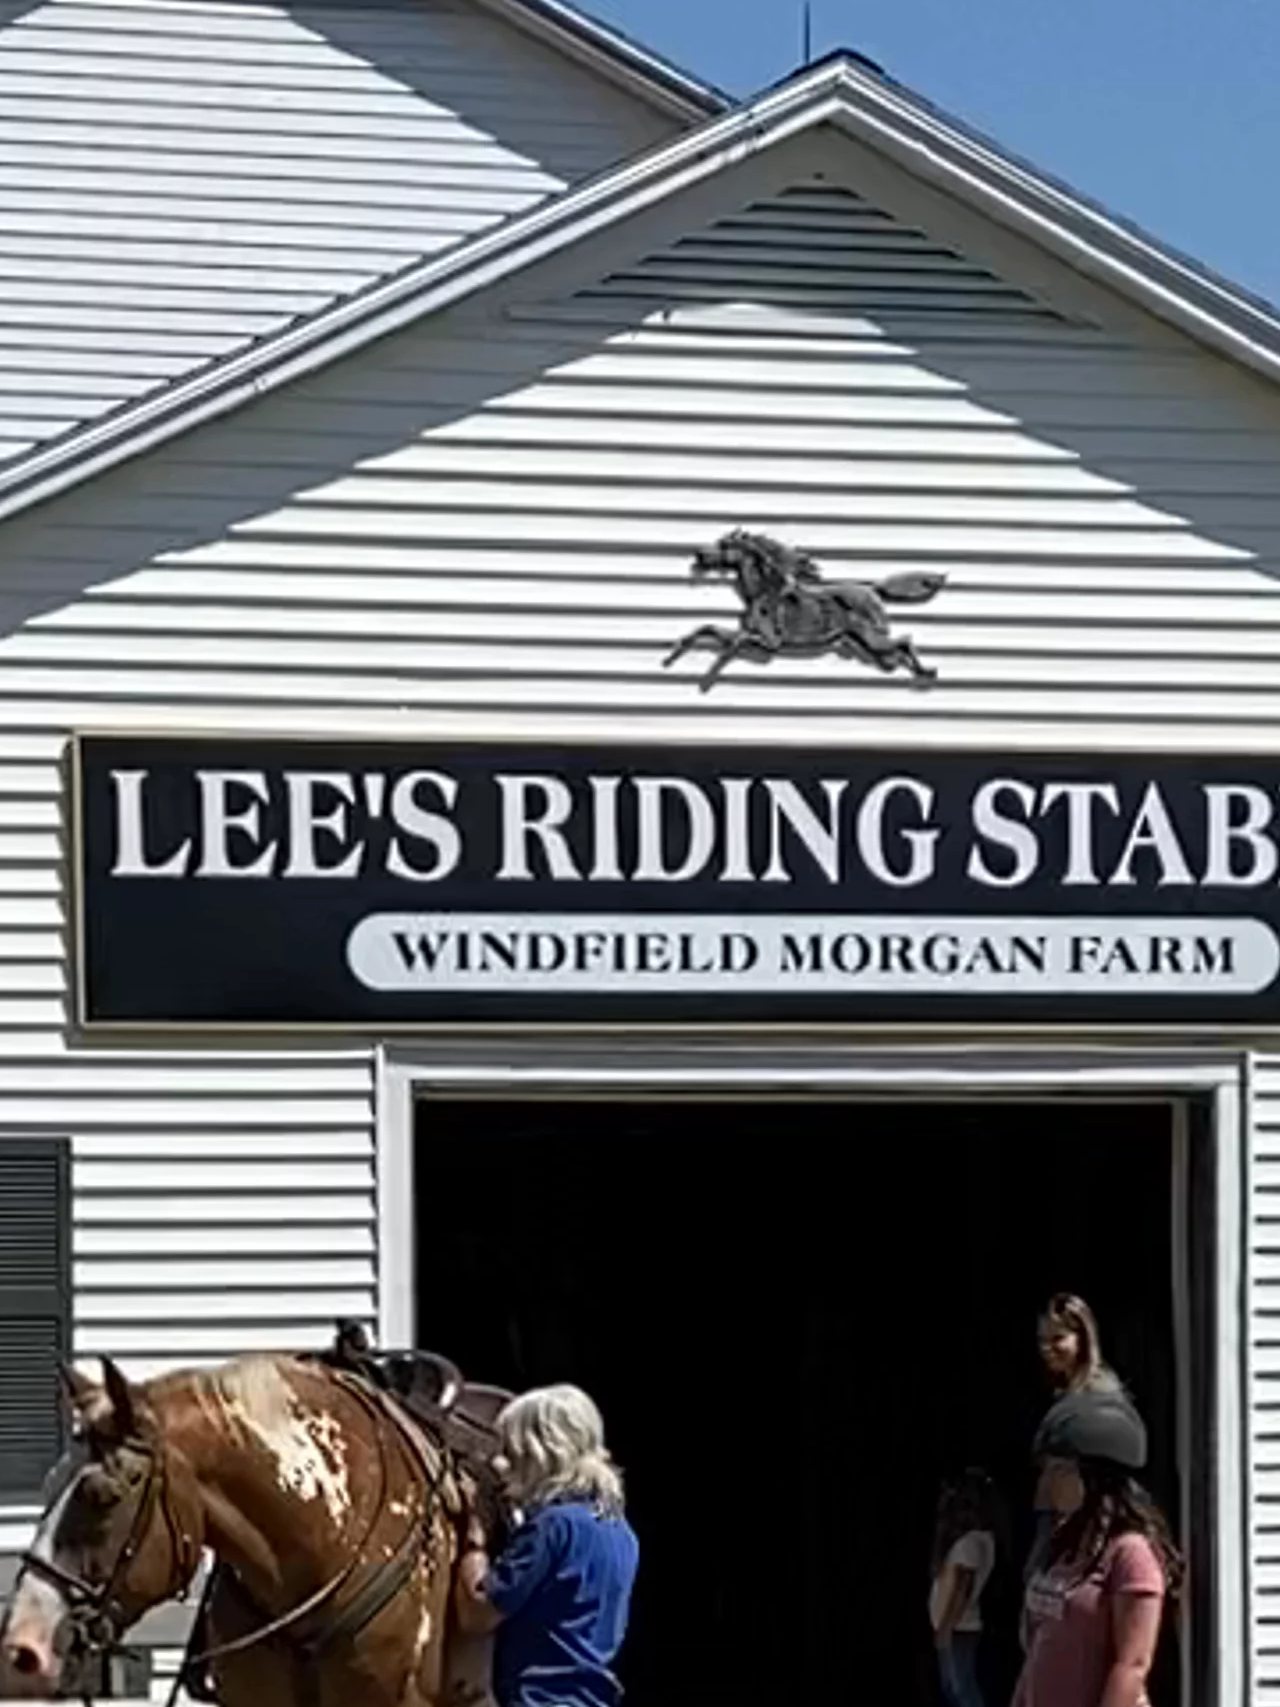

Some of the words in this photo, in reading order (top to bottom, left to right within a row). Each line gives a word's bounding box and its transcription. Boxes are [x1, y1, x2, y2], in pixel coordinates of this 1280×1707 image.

[110, 769, 461, 882] LEE'S
[494, 774, 939, 886] RIDING
[392, 931, 760, 973] WINDFIELD
[780, 933, 1047, 973] MORGAN
[1069, 935, 1236, 975] FARM
